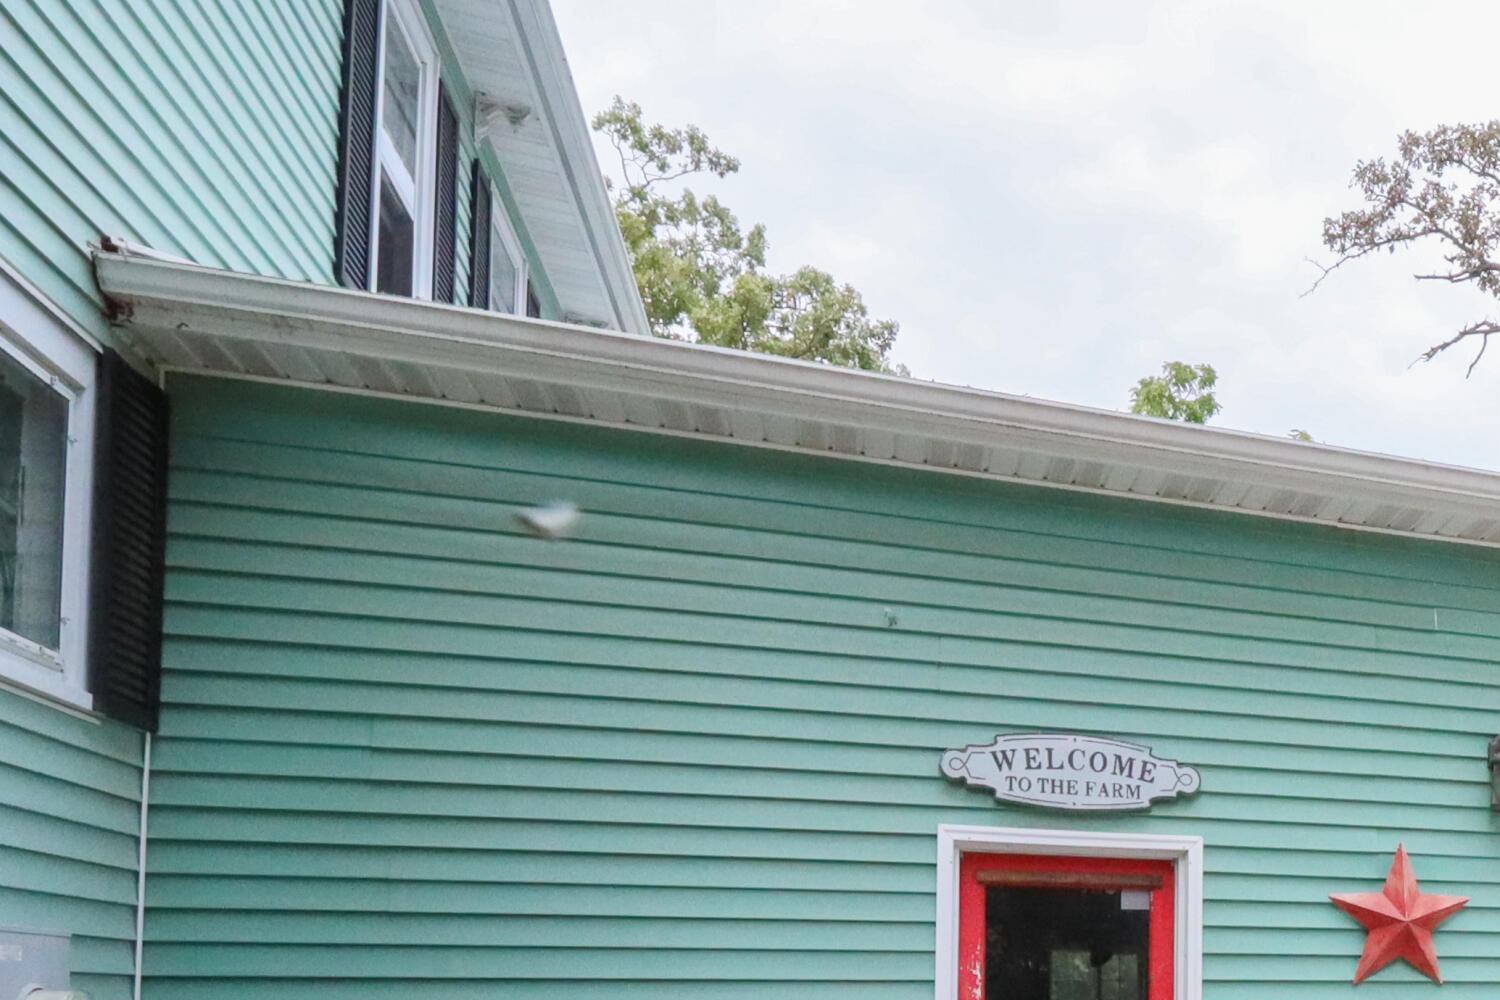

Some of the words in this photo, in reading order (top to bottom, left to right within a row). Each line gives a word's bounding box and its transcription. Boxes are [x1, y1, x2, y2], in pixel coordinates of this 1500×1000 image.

[991, 748, 1157, 783] WELCOME
[1004, 775, 1032, 793] TO
[1036, 777, 1079, 796] THE
[1085, 781, 1142, 800] FARM
